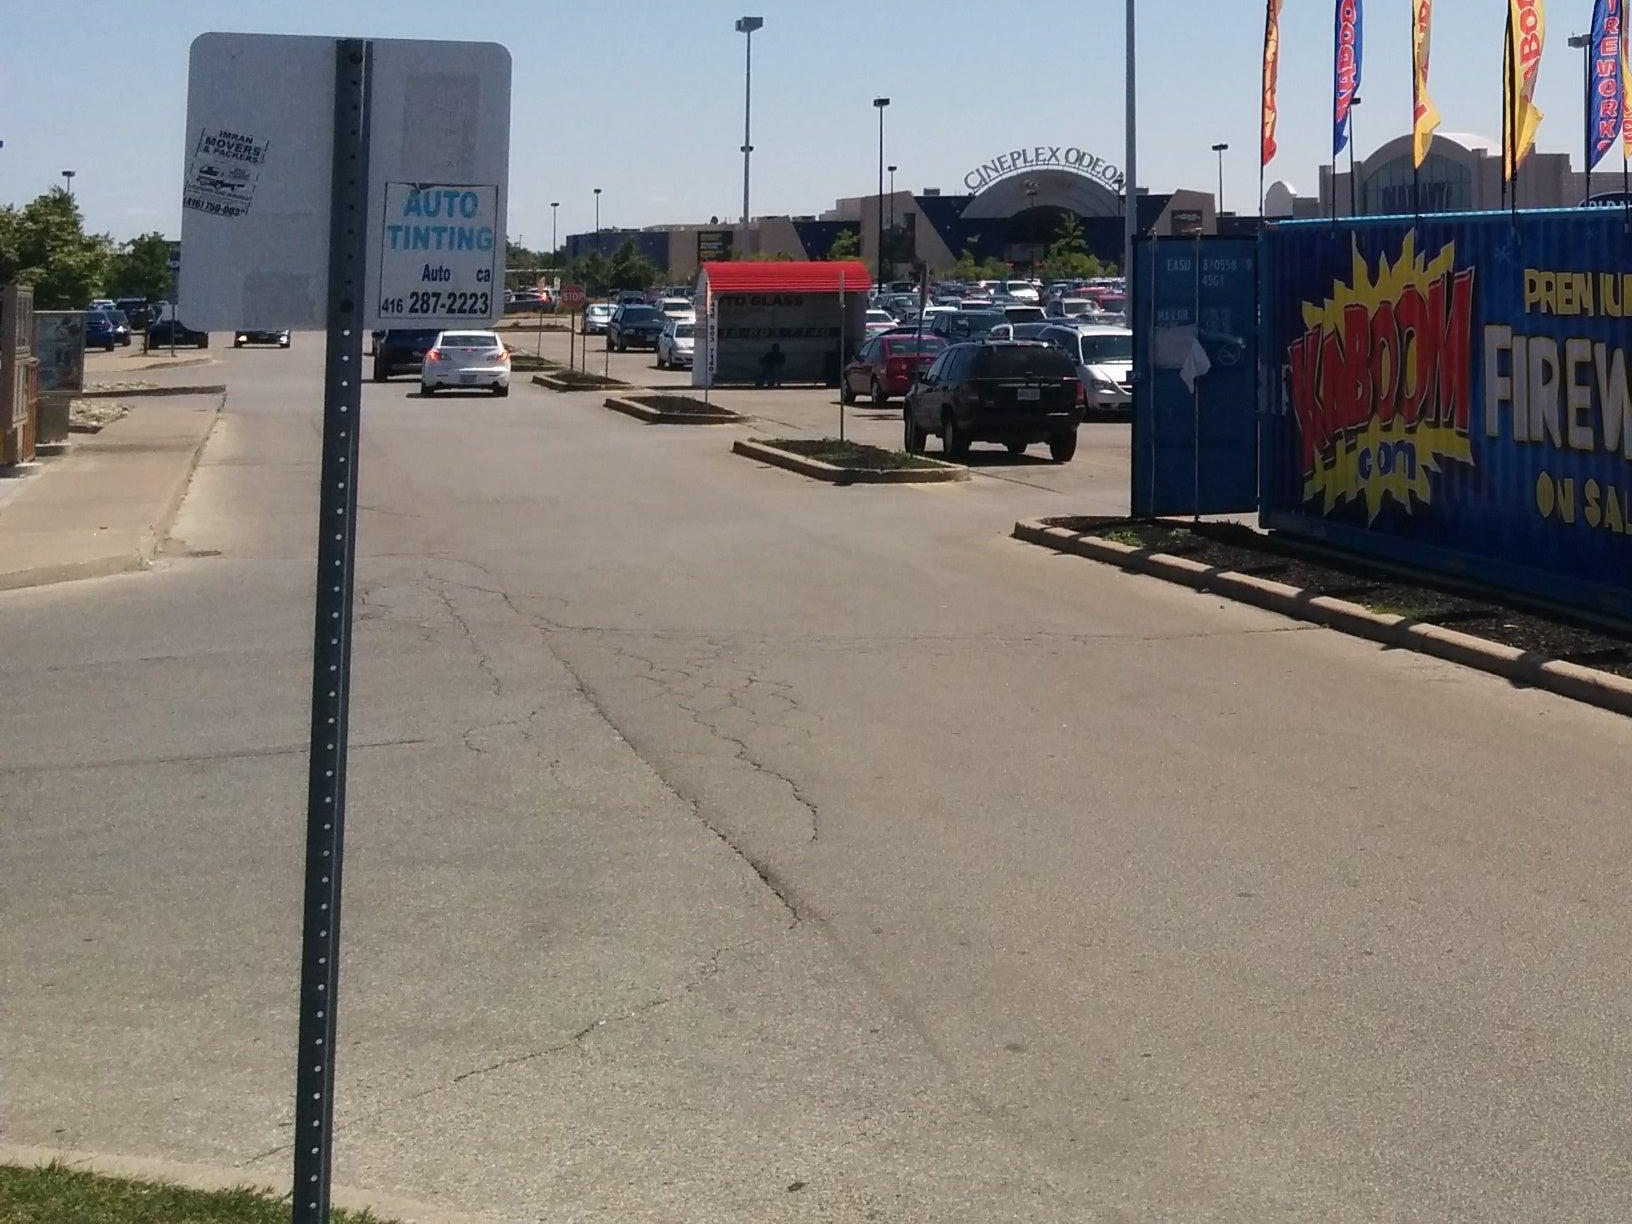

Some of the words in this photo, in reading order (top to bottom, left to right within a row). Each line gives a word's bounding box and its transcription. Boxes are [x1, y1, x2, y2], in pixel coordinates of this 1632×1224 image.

[204, 137, 260, 156] MOVERS
[219, 131, 253, 144] IMRAN
[213, 147, 258, 163] PACKERS
[964, 147, 1060, 191] CINEPLEX
[403, 189, 478, 218] AUTO
[387, 224, 493, 251] TINTING
[421, 264, 451, 282] Auto
[476, 268, 490, 282] ca
[383, 298, 403, 313] 416
[409, 292, 489, 314] 287-2223
[562, 291, 584, 301] STOP
[750, 295, 804, 307] GLASS
[1288, 266, 1475, 477] KABOOM
[1536, 471, 1575, 524] ON
